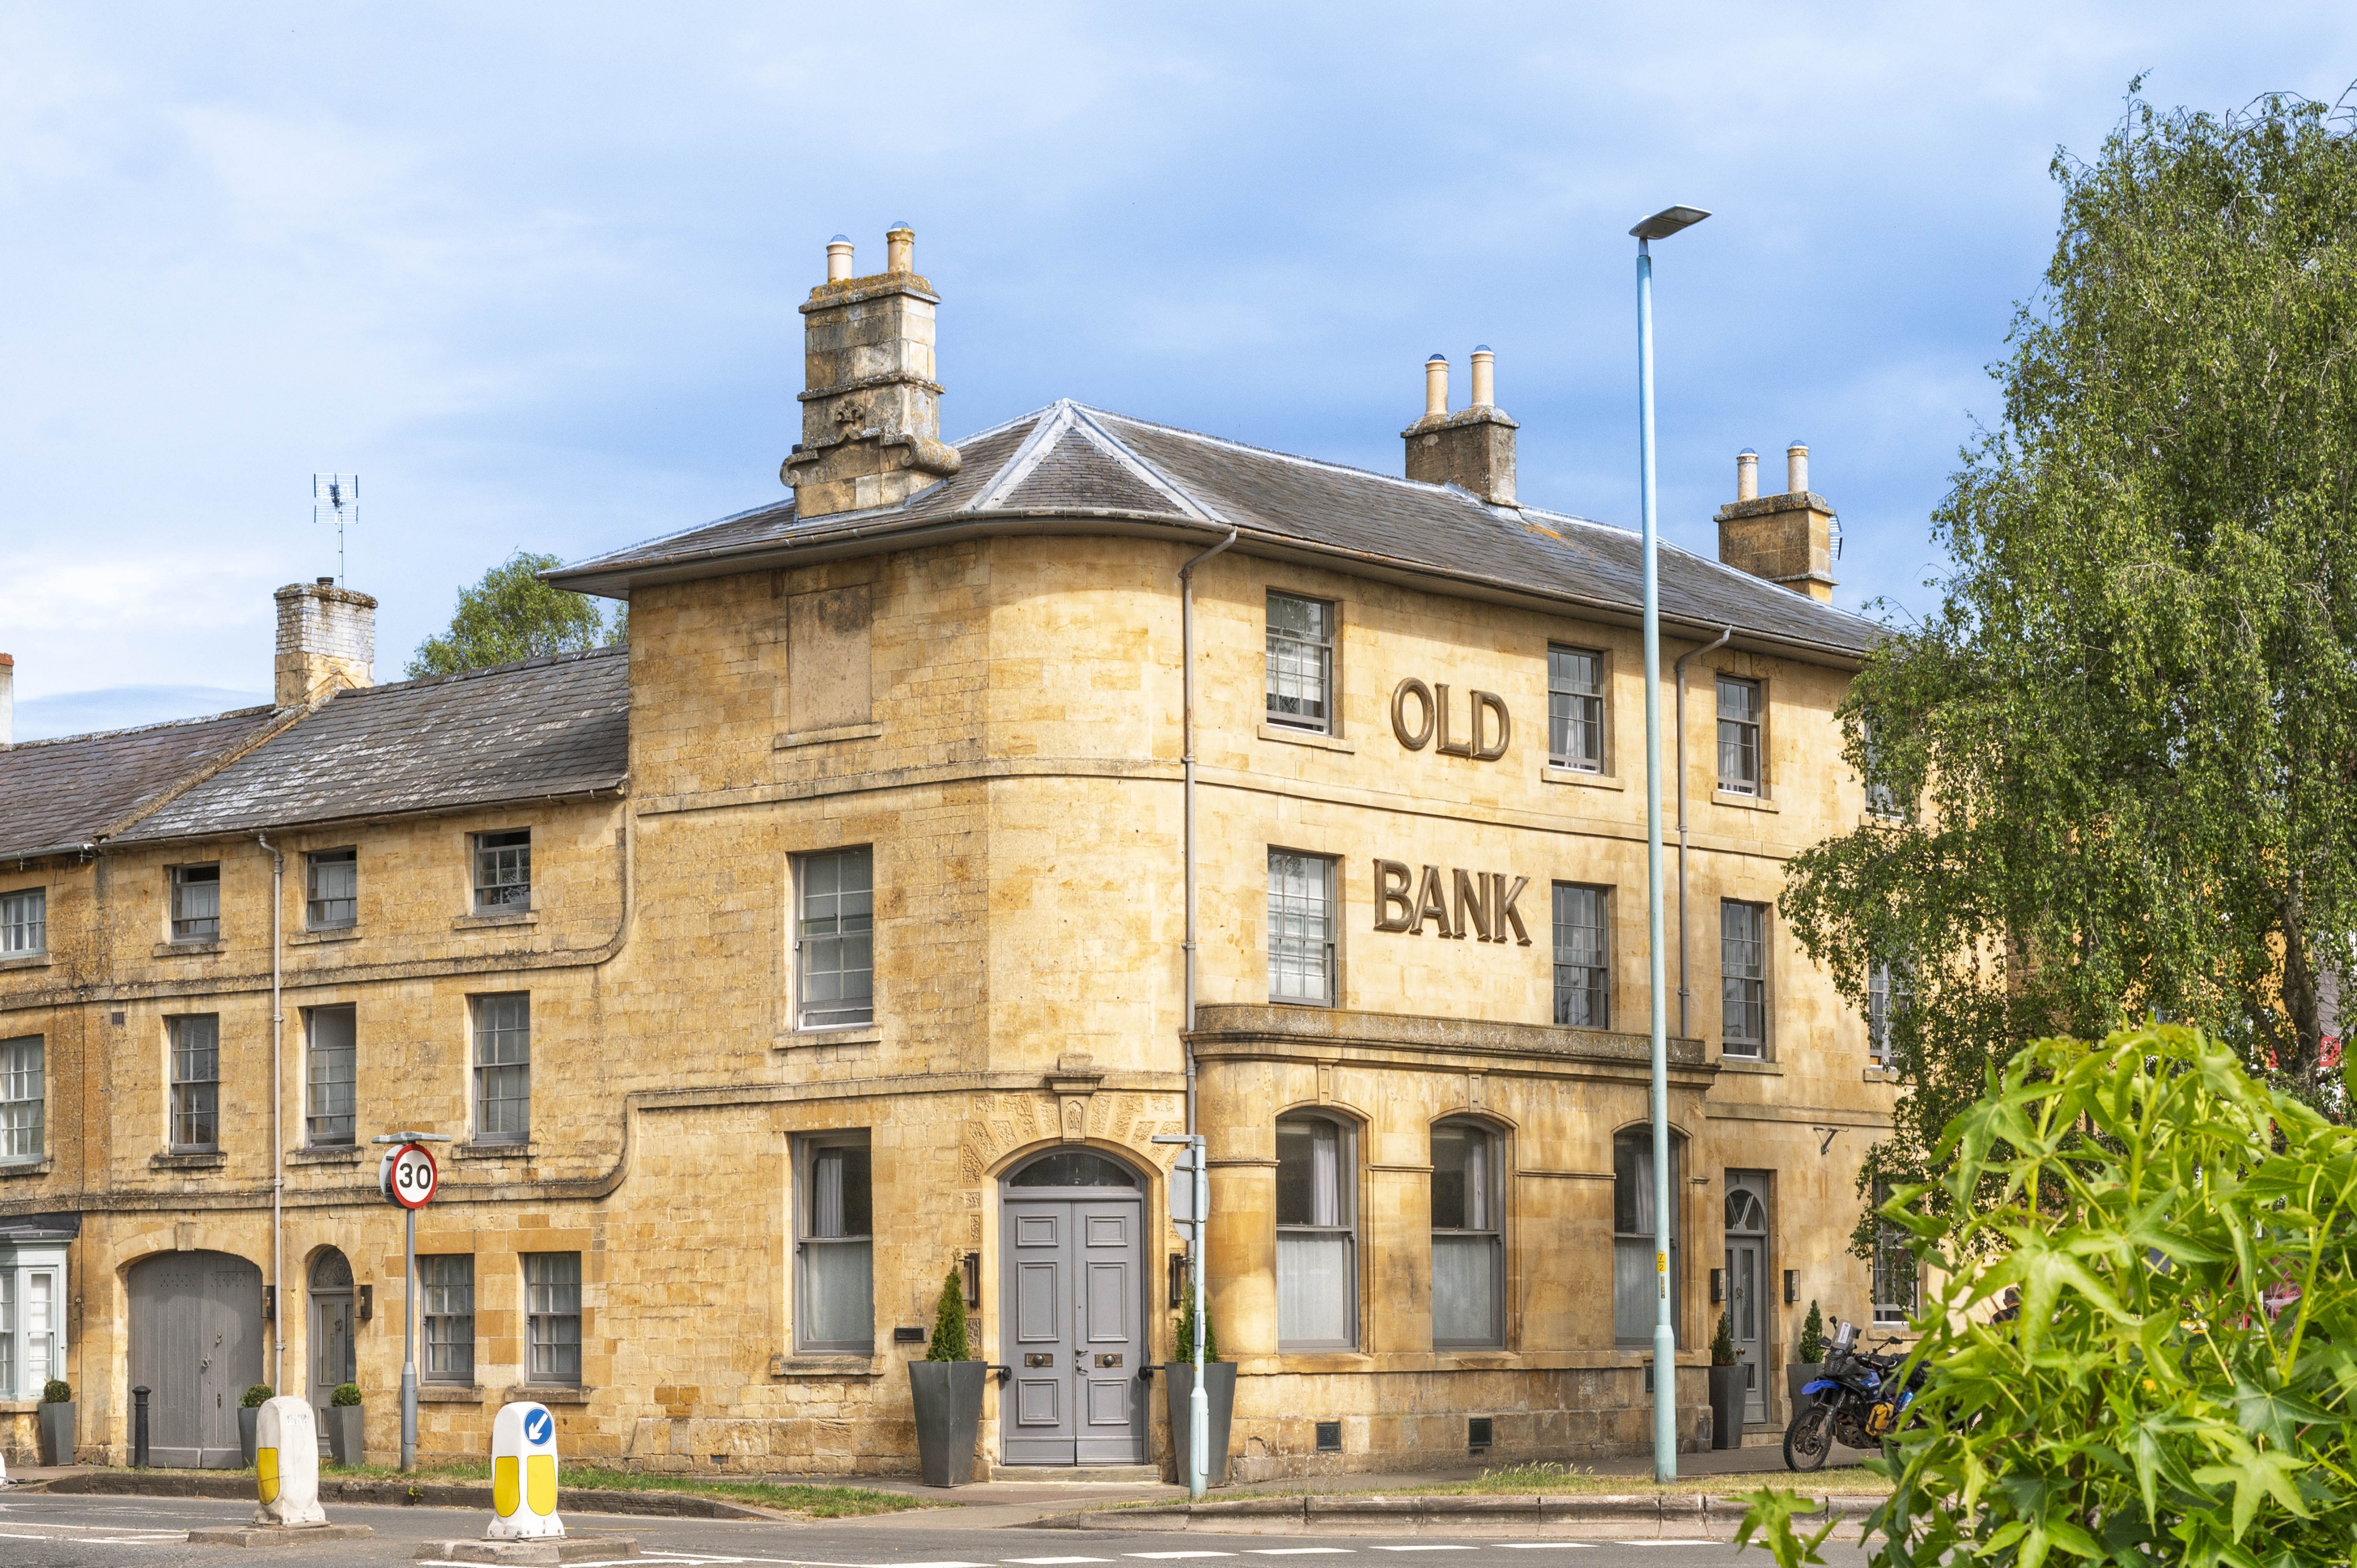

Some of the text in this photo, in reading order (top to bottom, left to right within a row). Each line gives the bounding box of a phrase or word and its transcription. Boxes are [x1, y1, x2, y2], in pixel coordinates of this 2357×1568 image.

[1392, 677, 1510, 761] OLD
[1373, 858, 1532, 946] BANK
[399, 1163, 431, 1189] 30
